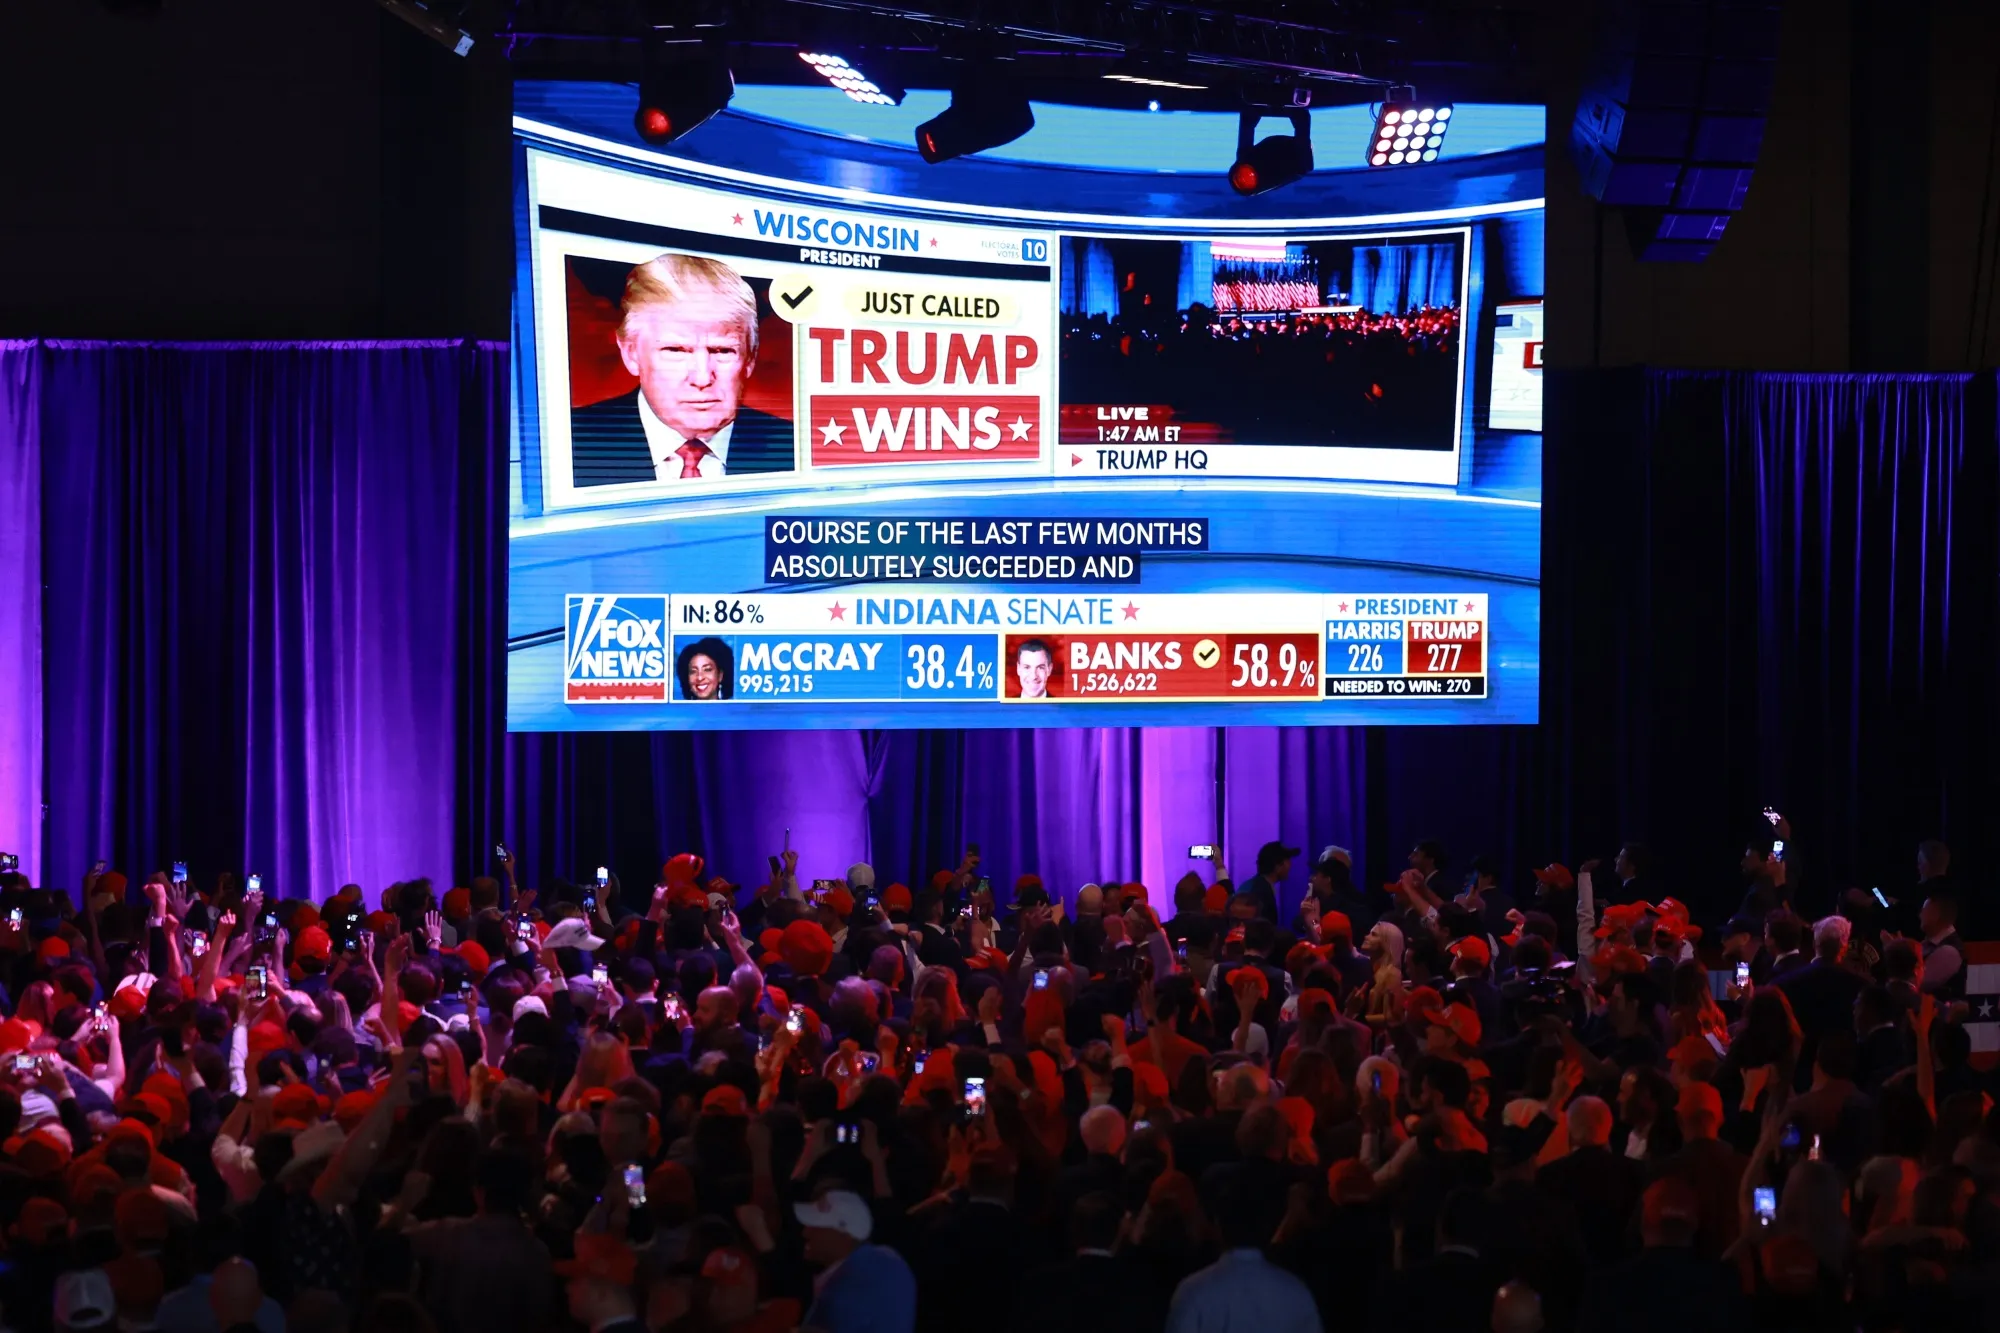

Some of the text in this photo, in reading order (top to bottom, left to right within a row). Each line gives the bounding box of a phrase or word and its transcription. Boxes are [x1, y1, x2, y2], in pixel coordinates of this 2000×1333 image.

[753, 209, 920, 252] WISCONSIN
[799, 248, 881, 270] PRESIDENT
[1025, 240, 1046, 260] 10
[860, 290, 1000, 319] JUST CALLED
[808, 328, 1039, 386] TRUMP
[1096, 406, 1149, 421] LIVE
[852, 405, 1002, 453] WINS
[1096, 425, 1181, 443] 1:47 AM ET
[1096, 449, 1209, 471] TRUMP HQ
[770, 521, 1203, 545] COURSE OF THE LAST FEW MONTHS
[770, 555, 1134, 579] ABSOLUTELY SUCCEEDED AND
[855, 598, 1113, 625] INDIANA SENATE
[1355, 598, 1458, 616] PRESIDENT
[600, 619, 663, 648] FOX
[1328, 621, 1402, 641] HARRIS
[1410, 621, 1480, 640] TRUMP
[581, 650, 664, 678] NEWS
[739, 642, 884, 671] MCCRAY
[906, 644, 994, 690] 38.4%
[1069, 641, 1183, 671] BANKS
[1231, 643, 1316, 690] 58.9%
[1347, 645, 1383, 673] 226
[1426, 645, 1464, 673] 277
[739, 674, 814, 695] 995,215
[1071, 672, 1158, 693] 1,526,622
[1332, 680, 1471, 694] NEEDED TO WIN: 270
